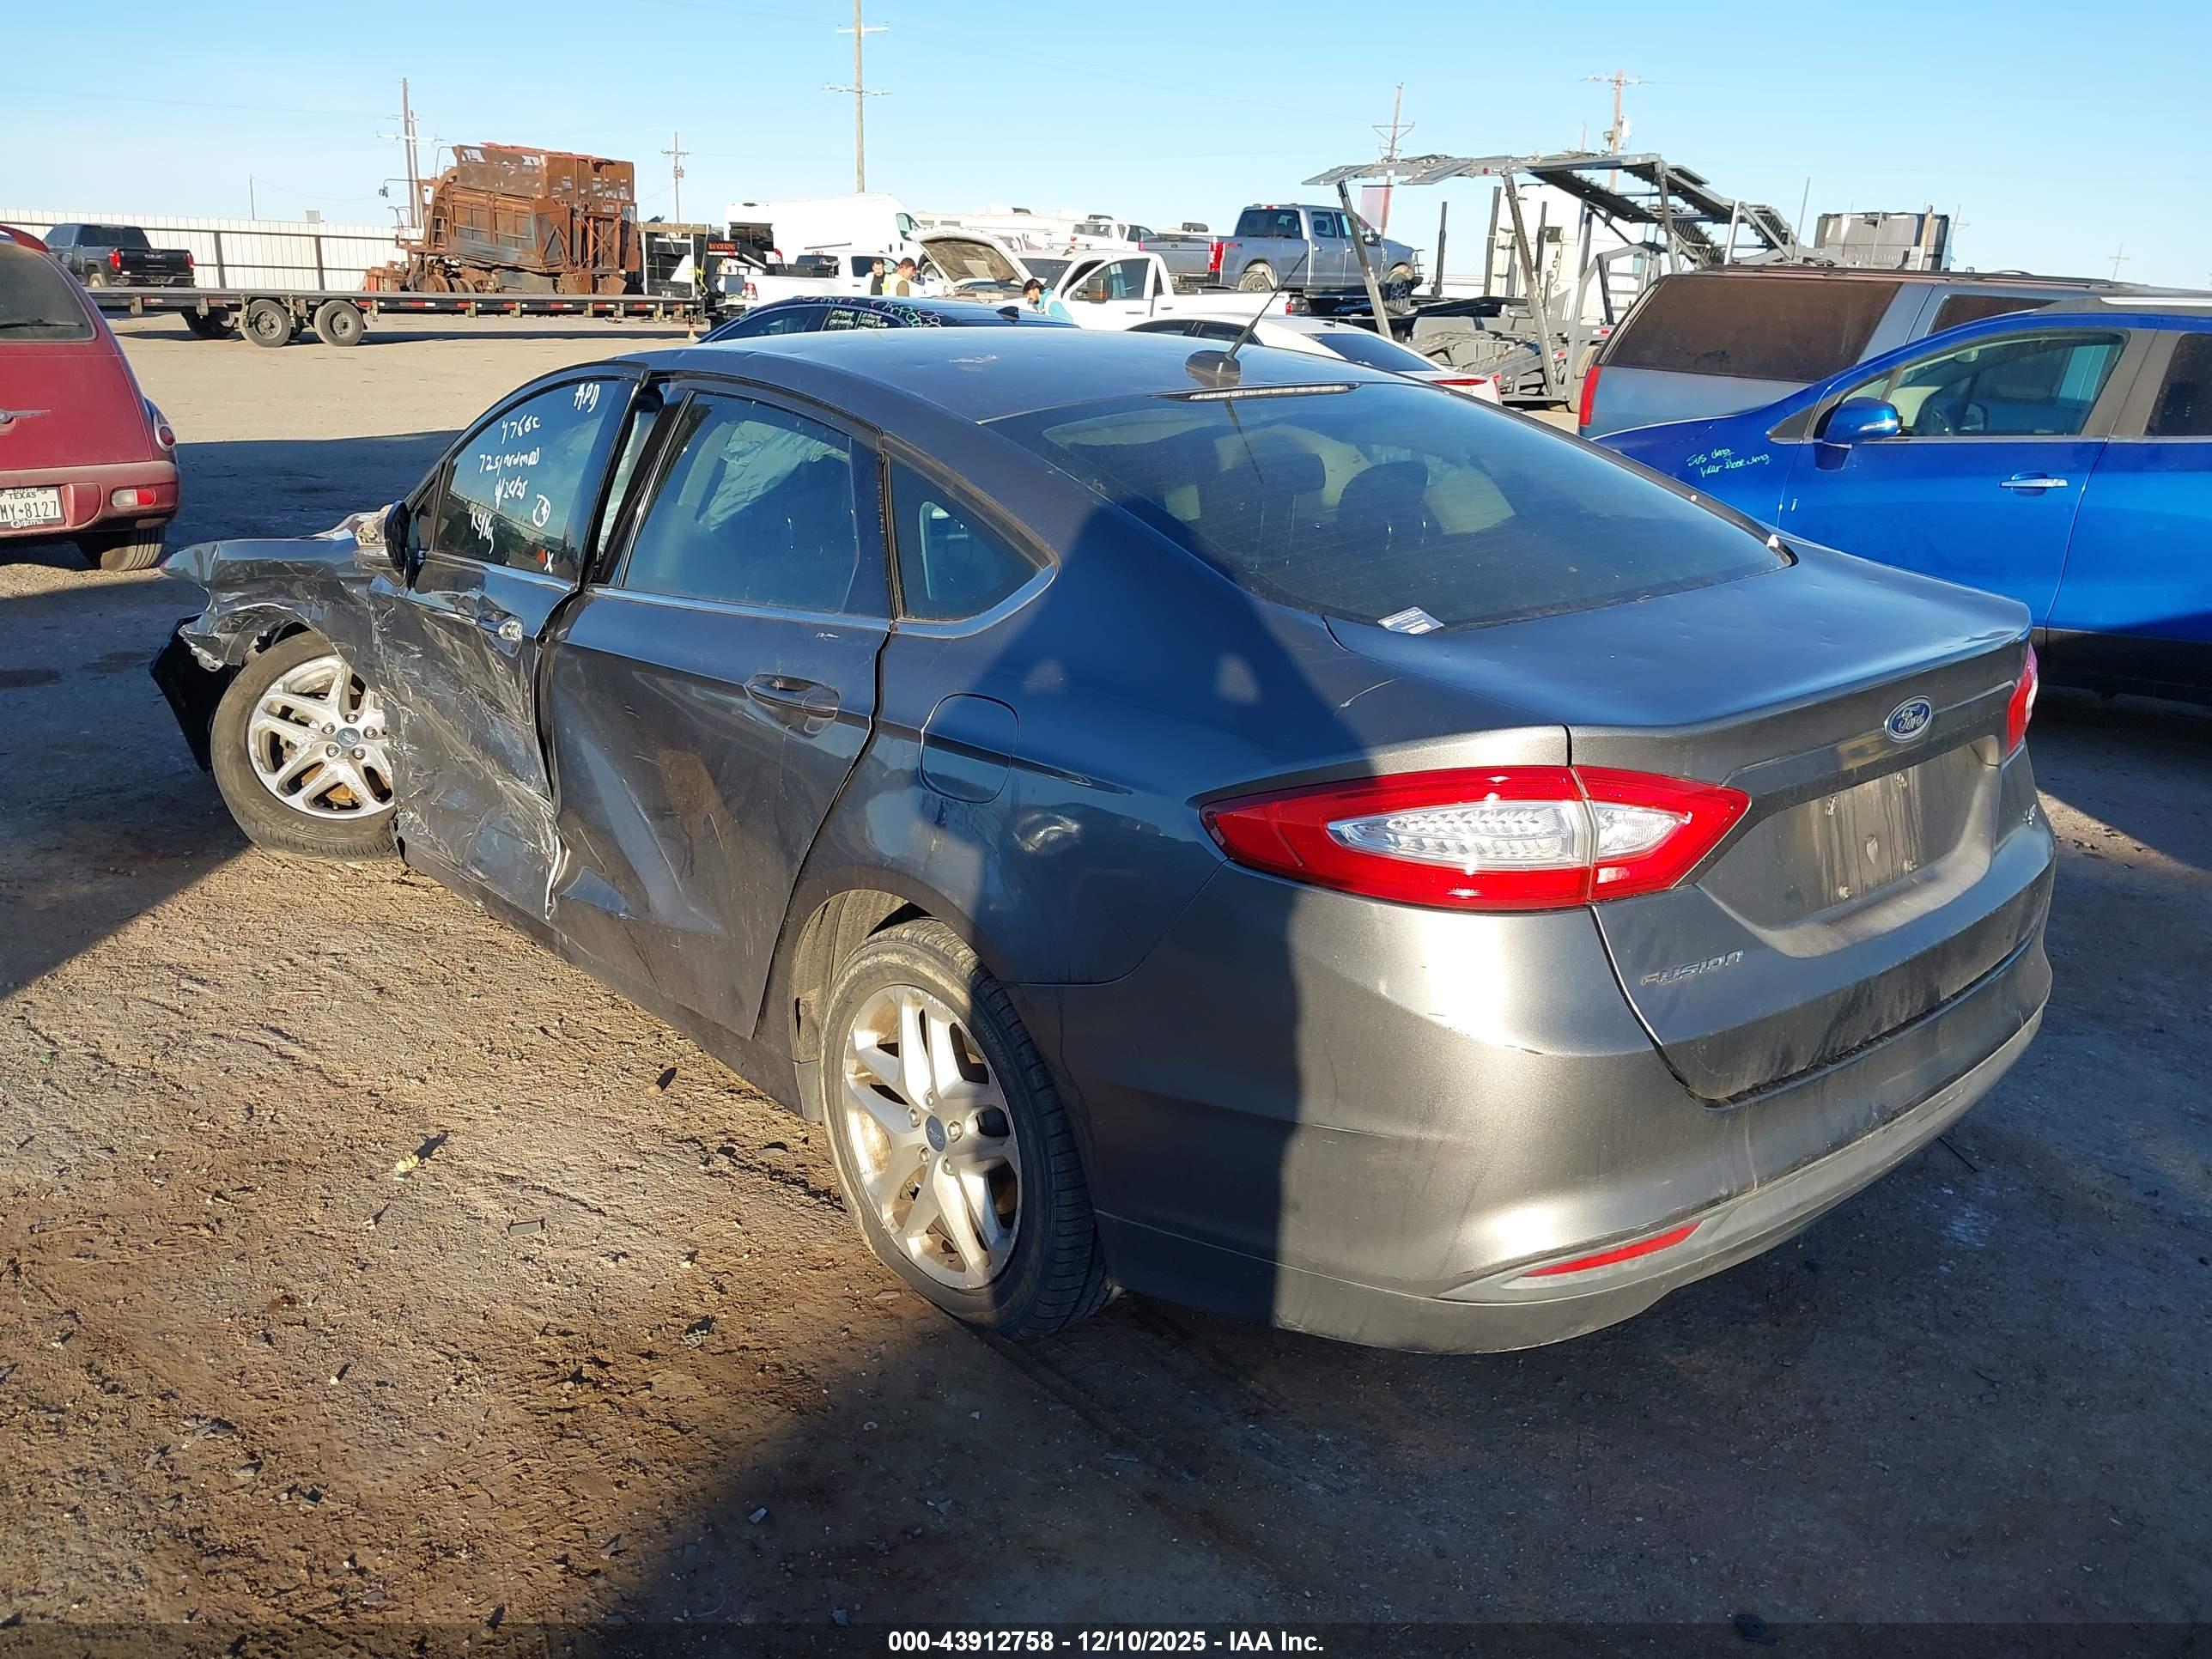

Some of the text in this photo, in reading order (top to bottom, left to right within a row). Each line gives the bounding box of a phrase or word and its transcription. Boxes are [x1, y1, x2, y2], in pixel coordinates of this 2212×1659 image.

[8, 491, 37, 501] TEXAS
[1898, 703, 1927, 732] Ford
[1640, 949, 1743, 987] FUSION
